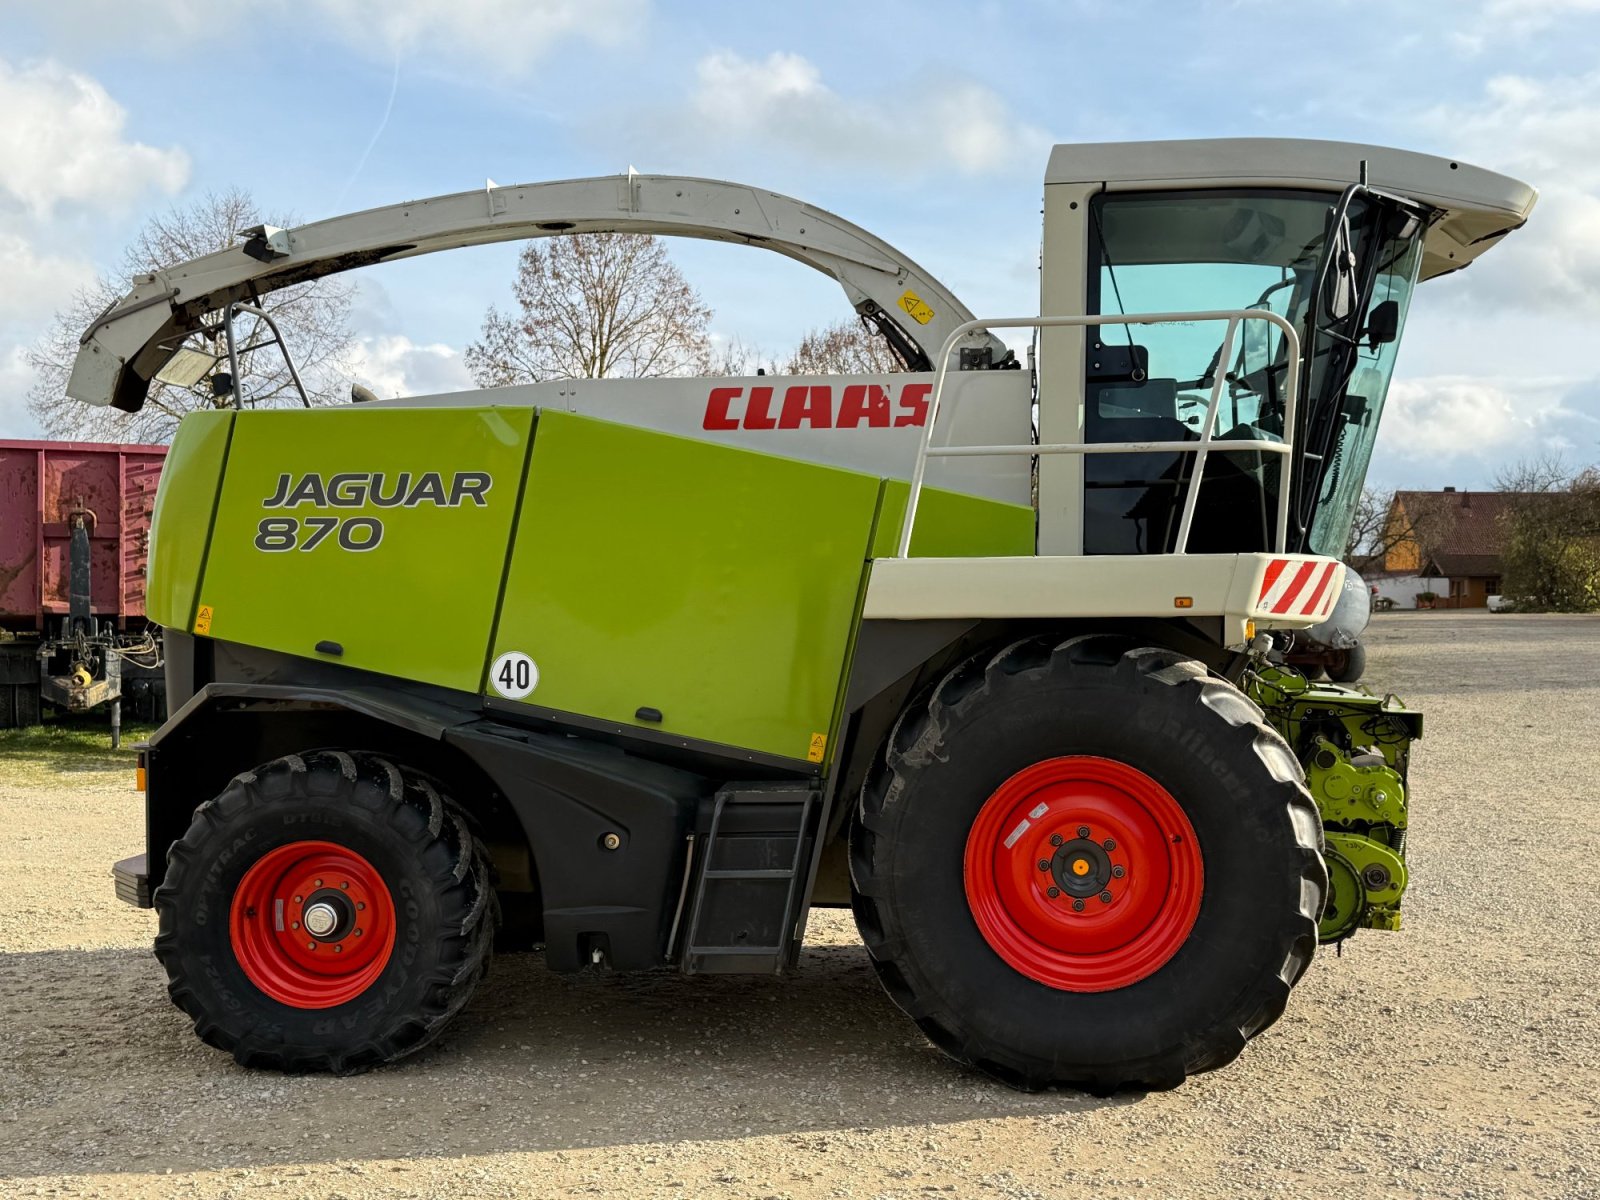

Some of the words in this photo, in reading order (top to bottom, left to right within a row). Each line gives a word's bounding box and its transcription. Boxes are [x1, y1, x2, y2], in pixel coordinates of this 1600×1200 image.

[702, 384, 940, 431] CLAAS
[262, 472, 493, 508] JAGUAR
[254, 516, 385, 552] 870
[499, 660, 529, 689] 40
[195, 827, 257, 926] OPTITRAC
